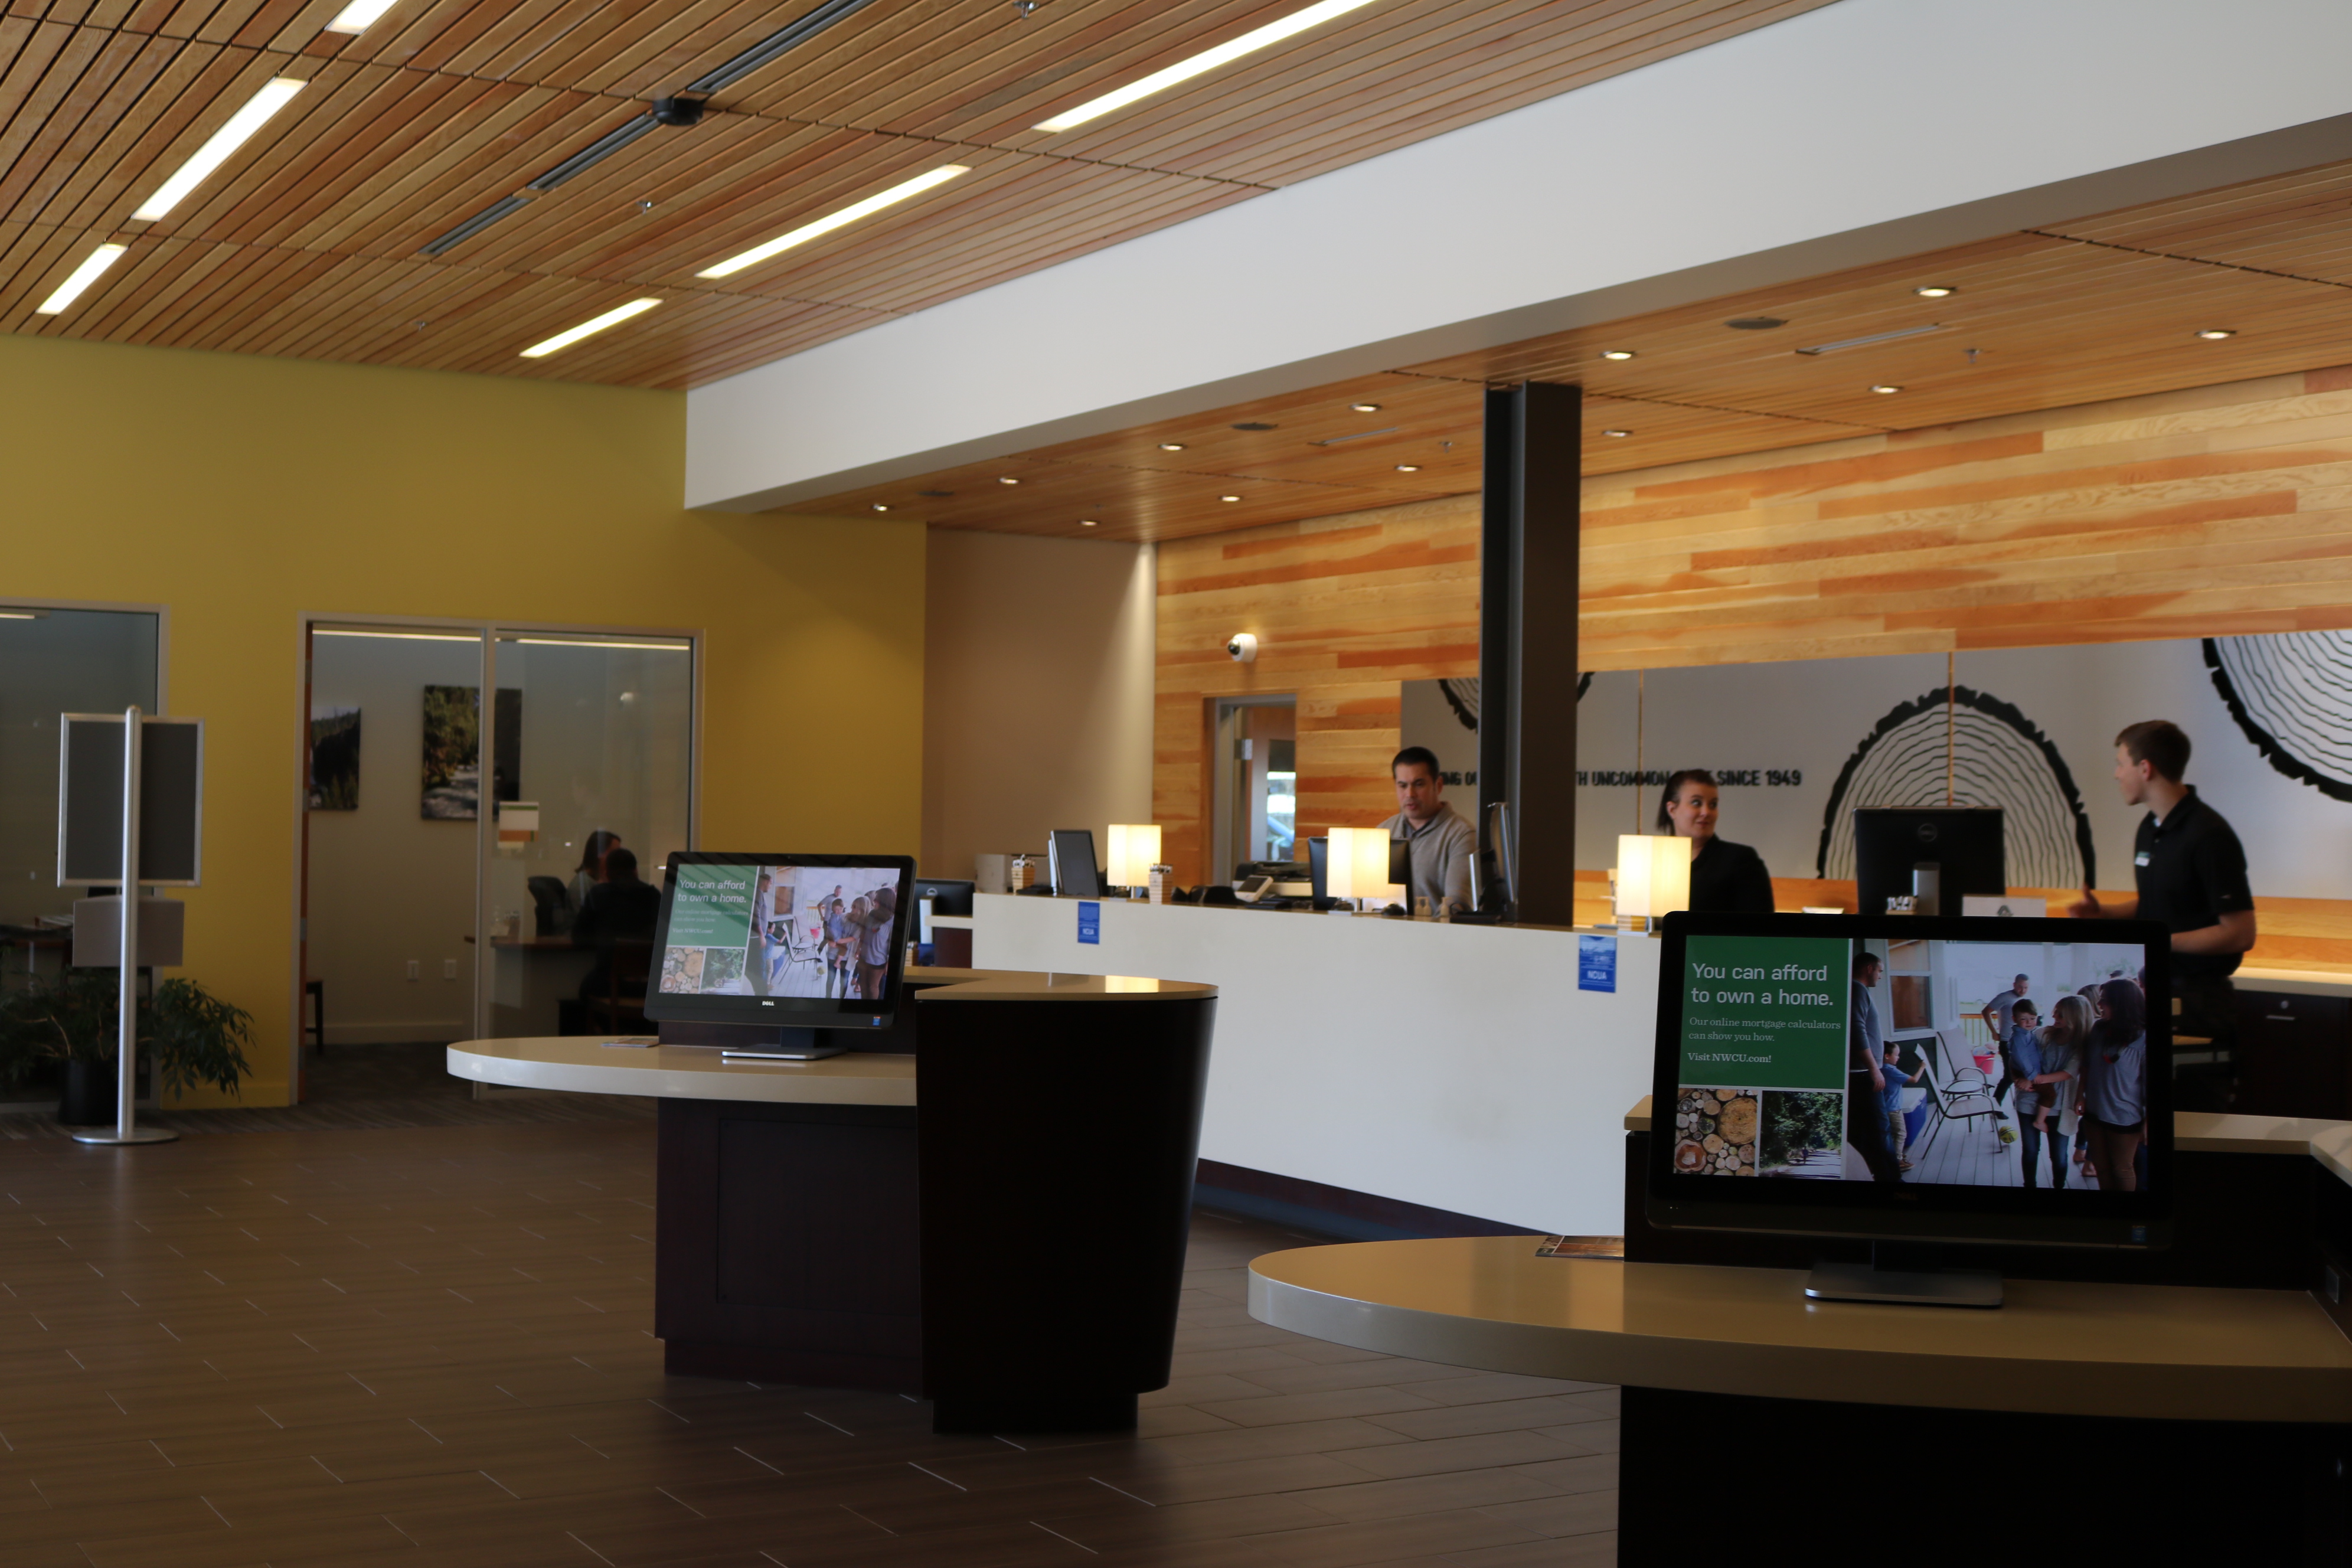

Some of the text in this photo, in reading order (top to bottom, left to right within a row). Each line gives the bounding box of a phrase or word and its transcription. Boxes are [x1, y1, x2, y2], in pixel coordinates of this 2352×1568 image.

[1592, 770, 1670, 786] UNCOMMON
[1717, 770, 1760, 786] SINCE
[1765, 770, 1801, 786] 1949
[680, 880, 696, 888] You
[718, 880, 746, 890] afford
[677, 893, 687, 901] to
[720, 893, 746, 903] home.
[1693, 963, 1828, 981] You can afford
[1691, 987, 1834, 1006] to own a home.
[1690, 1017, 1841, 1030] Our online mortgage calculators
[1707, 1031, 1733, 1040] show
[1734, 1034, 1752, 1042] you
[1753, 1032, 1775, 1041] how.
[1687, 1052, 1772, 1063] Visit NWCU.com!
